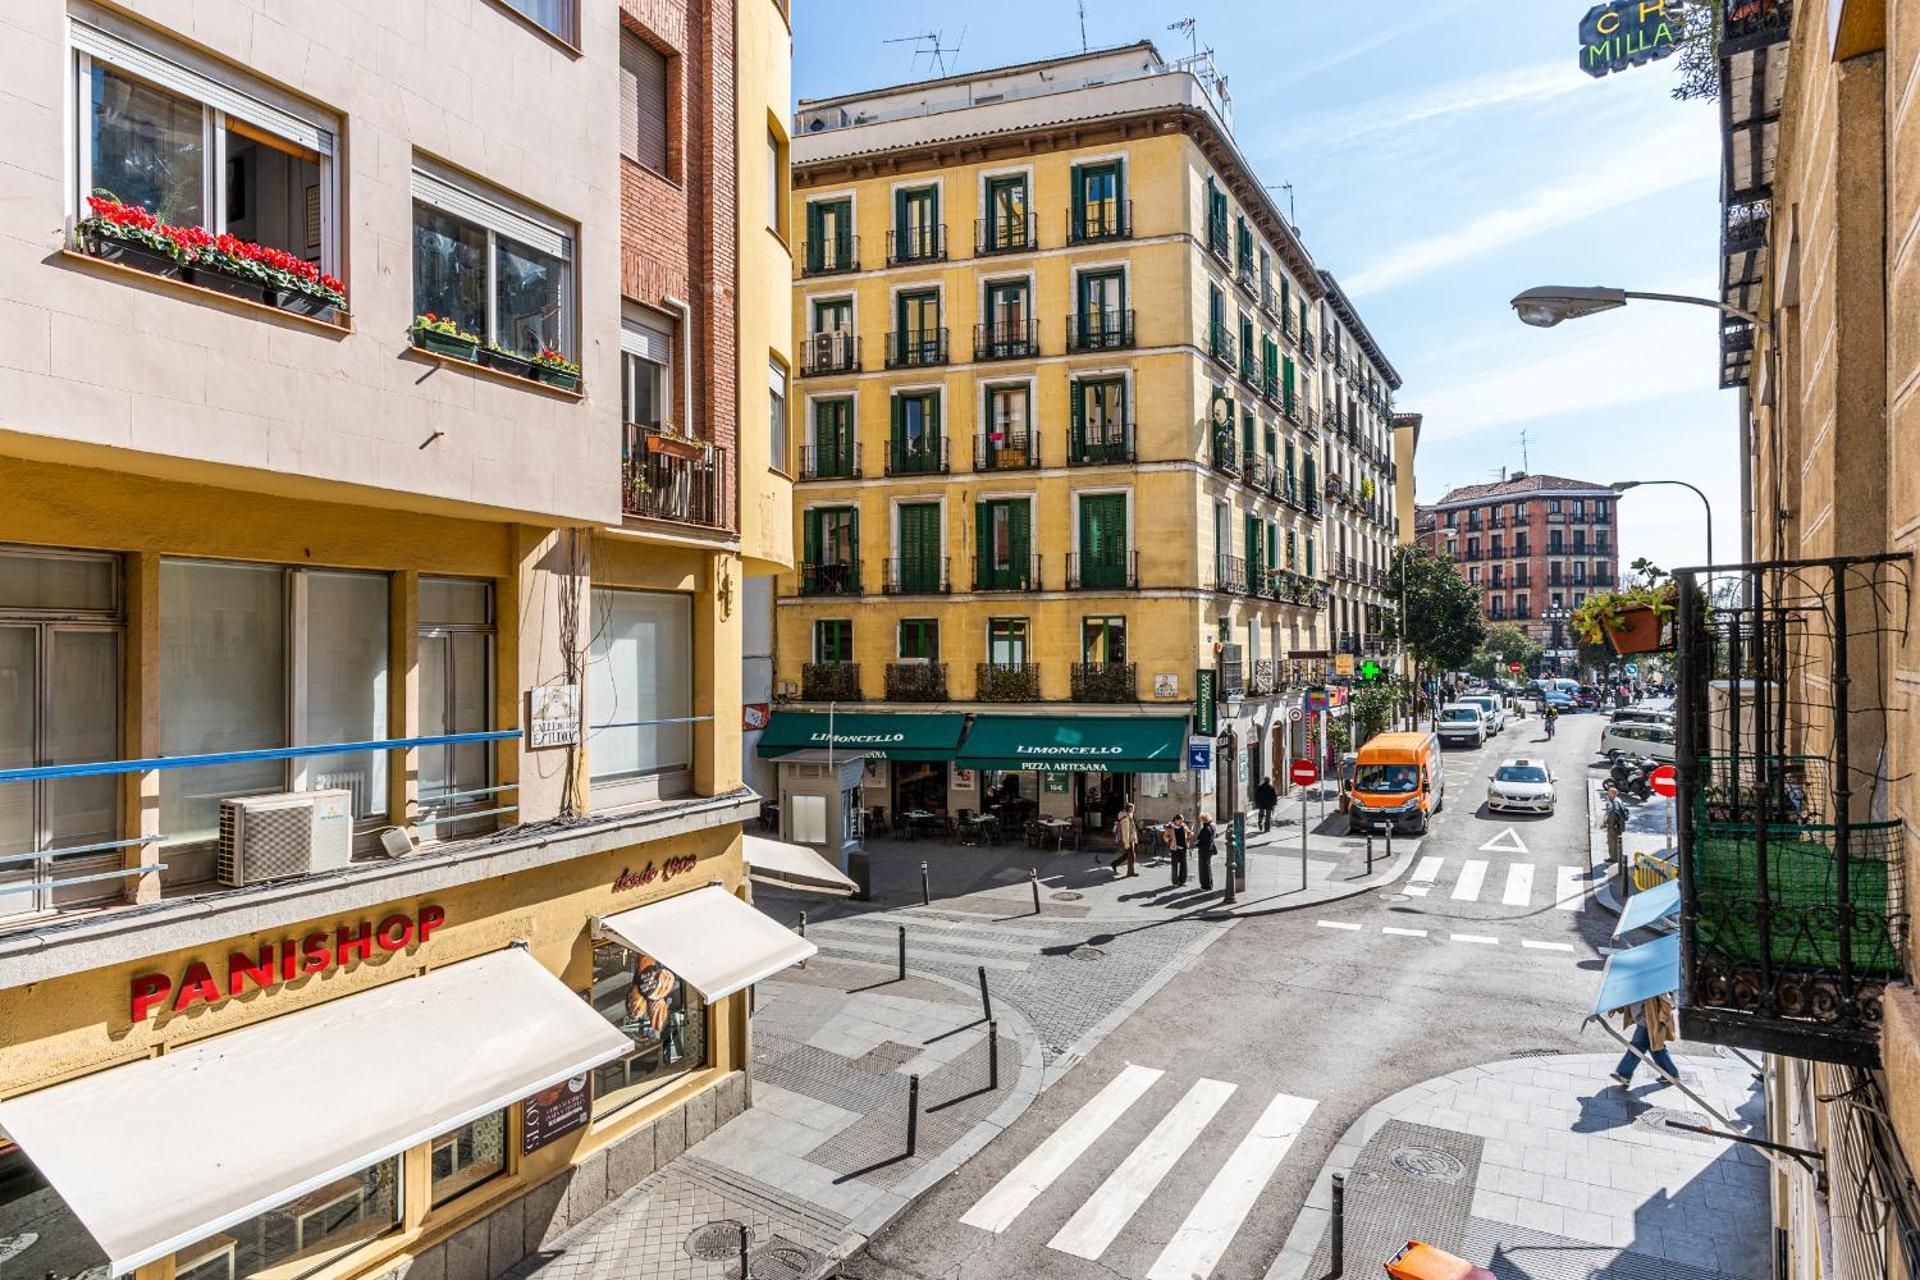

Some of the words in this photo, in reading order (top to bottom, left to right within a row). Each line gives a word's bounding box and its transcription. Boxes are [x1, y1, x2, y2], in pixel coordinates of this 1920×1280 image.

[810, 732, 905, 744] LIMONCELLO
[1016, 745, 1123, 755] LIMONCELLO
[1022, 762, 1051, 770] PIZZA
[1053, 763, 1108, 772] ARTESANA
[613, 860, 659, 893] desde
[131, 904, 445, 1024] PANISHOP
